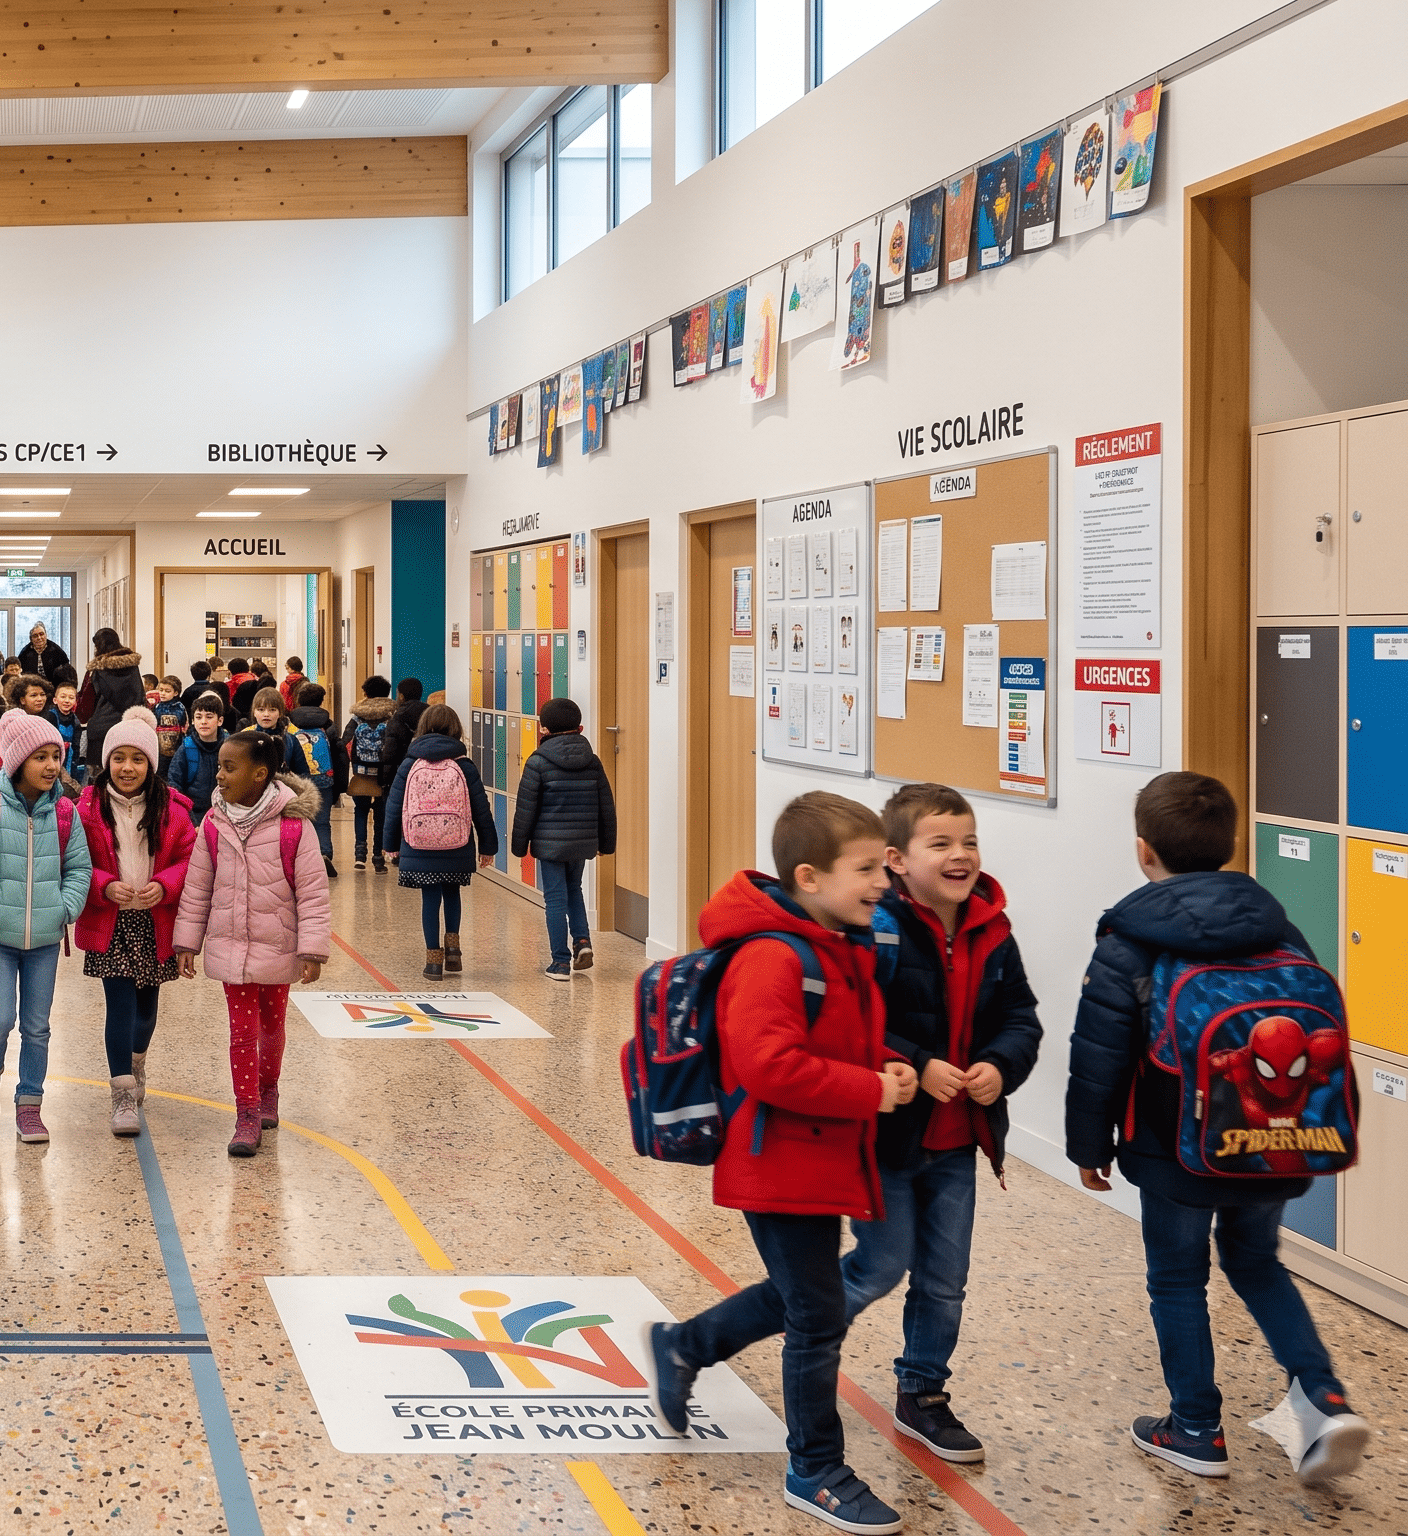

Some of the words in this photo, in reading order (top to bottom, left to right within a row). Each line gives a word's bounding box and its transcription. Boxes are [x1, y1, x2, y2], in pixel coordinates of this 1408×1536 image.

[897, 426, 925, 459] VIE
[930, 402, 1025, 453] SCOLAIRE
[15, 441, 85, 463] CP/CE1
[208, 438, 357, 467] BIBLIOTHÈQUE
[792, 499, 832, 523] AGENDA
[203, 538, 287, 556] ACCUEIL
[1083, 666, 1151, 687] URGENCES
[391, 1402, 516, 1418] ÉCOLE
[522, 1404, 711, 1418] PRIMAIE
[402, 1424, 525, 1440] JEAN
[535, 1423, 730, 1441] MOULN
